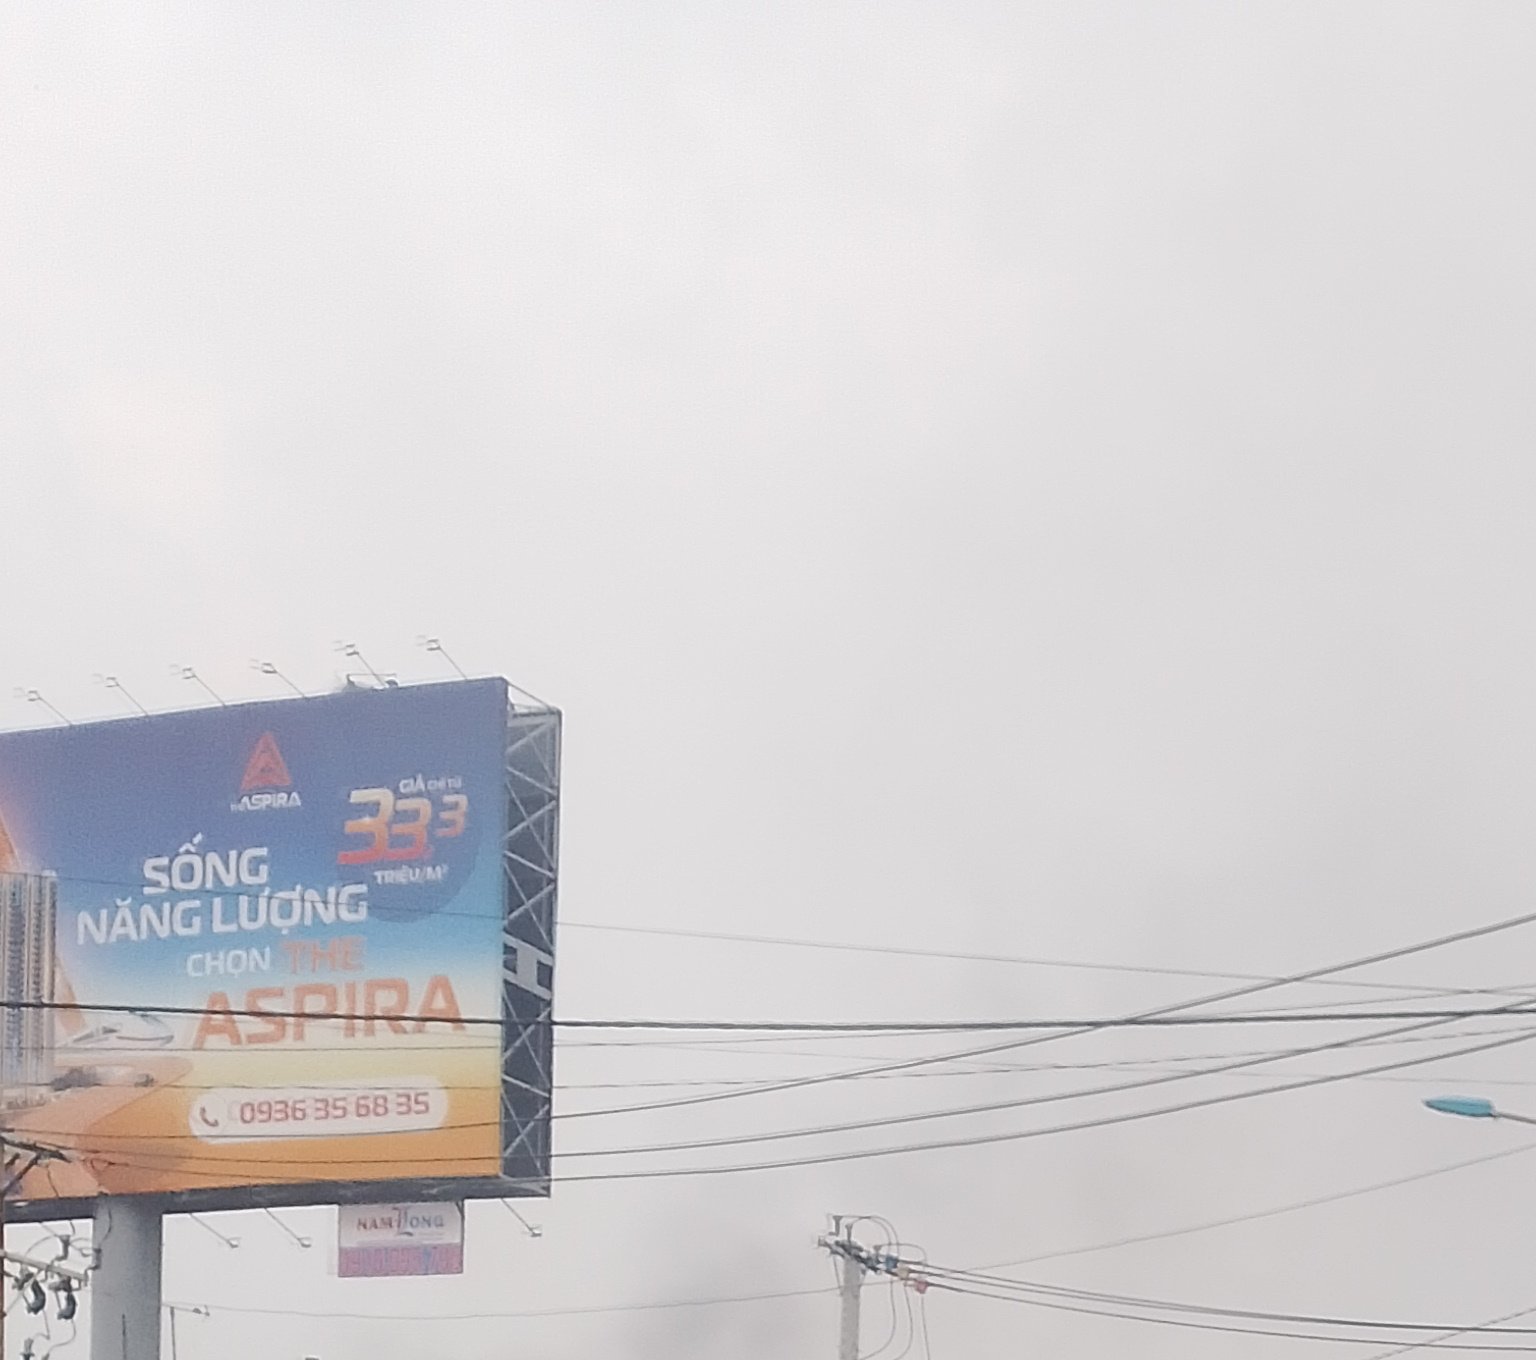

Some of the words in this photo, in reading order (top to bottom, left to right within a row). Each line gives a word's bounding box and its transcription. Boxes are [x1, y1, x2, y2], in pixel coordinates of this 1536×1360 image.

[241, 791, 302, 811] ASPIRA
[143, 832, 268, 895] SỐNG
[77, 896, 201, 945] NĂNG
[211, 883, 368, 935] LƯỢNG
[186, 946, 271, 978] CHỌN
[282, 935, 366, 975] THE
[192, 974, 466, 1051] ASPIRA
[240, 1100, 306, 1125] 0936
[314, 1097, 347, 1120] 35
[355, 1095, 389, 1118] 68
[396, 1092, 430, 1116] 35
